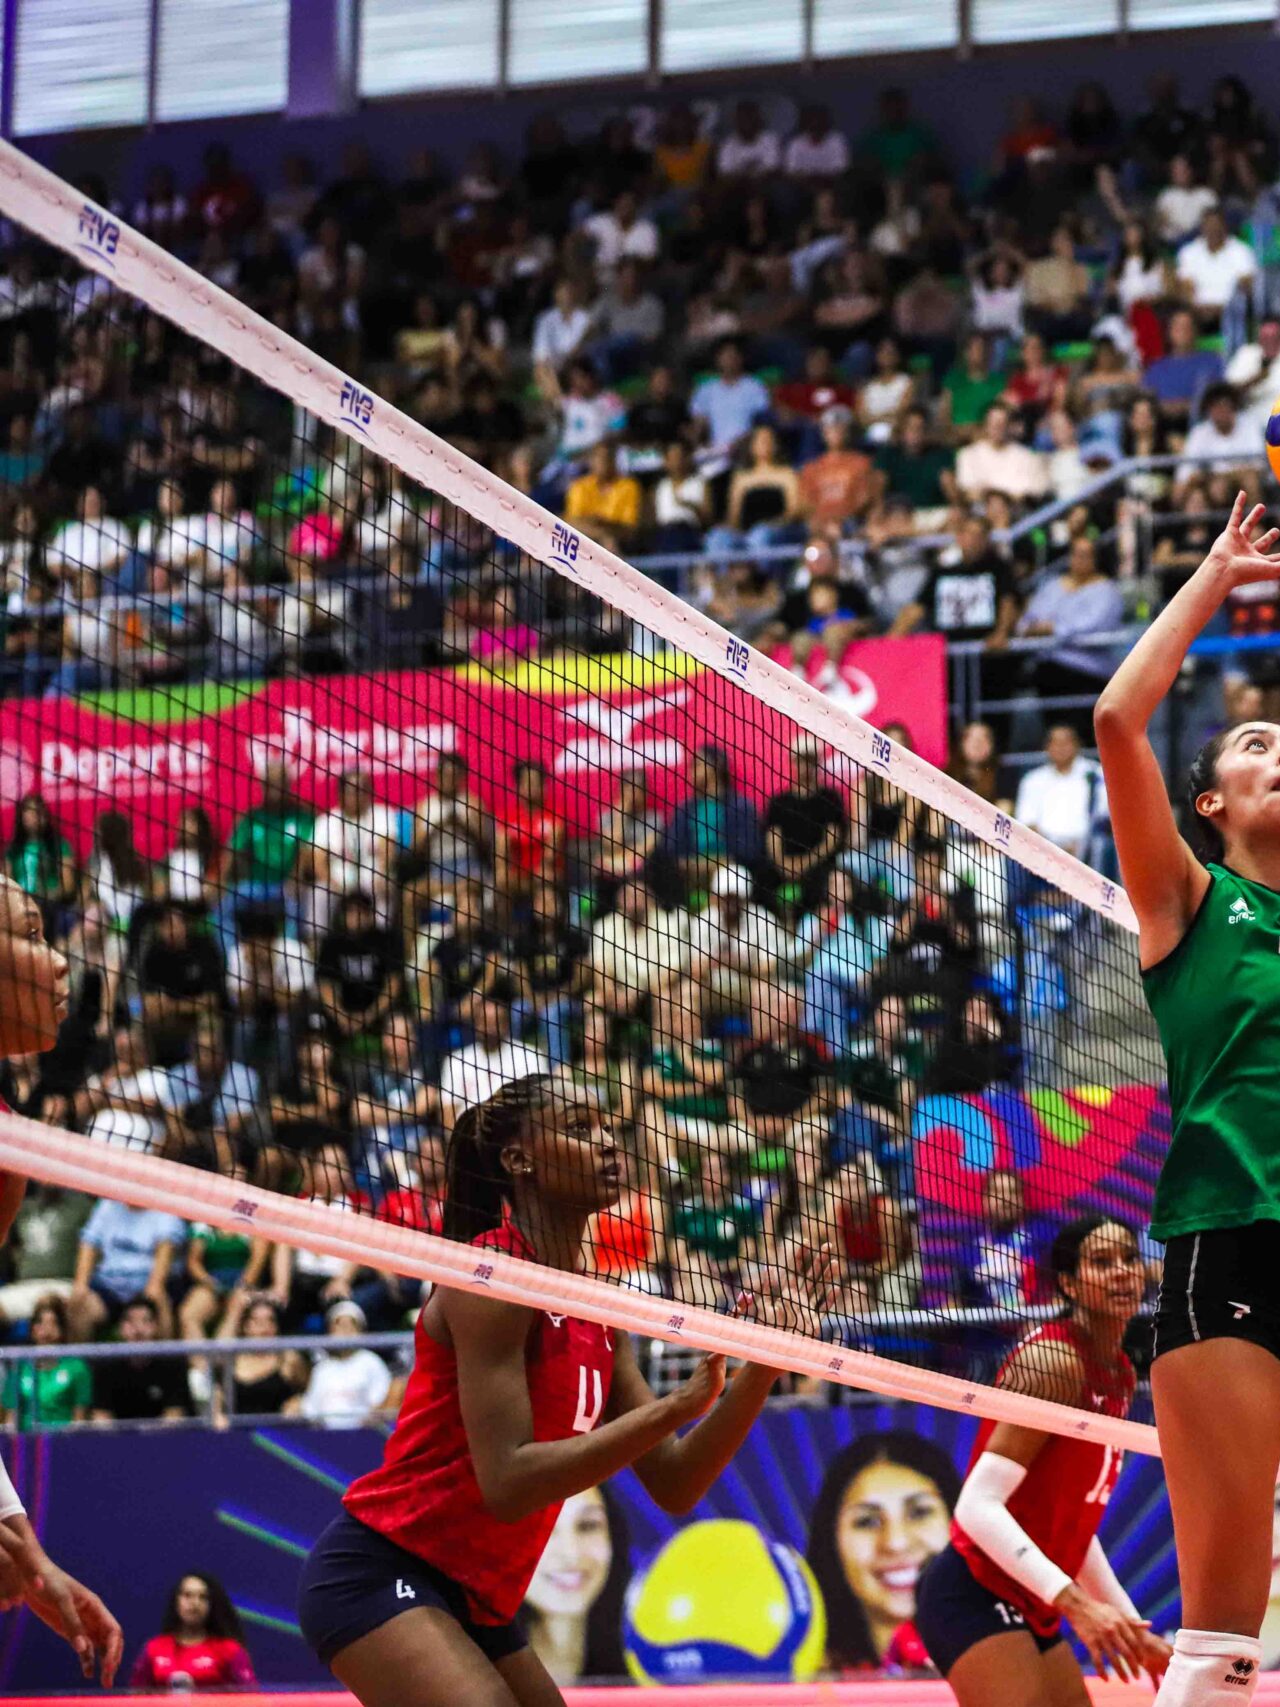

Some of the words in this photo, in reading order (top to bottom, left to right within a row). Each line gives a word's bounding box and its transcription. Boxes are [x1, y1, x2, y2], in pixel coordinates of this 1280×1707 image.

[78, 204, 121, 255] FIVB
[340, 381, 374, 425] FIVB
[551, 523, 580, 562] FIVB
[726, 637, 749, 671] FIVB
[872, 733, 891, 764] FIVB
[396, 1579, 416, 1599] 4
